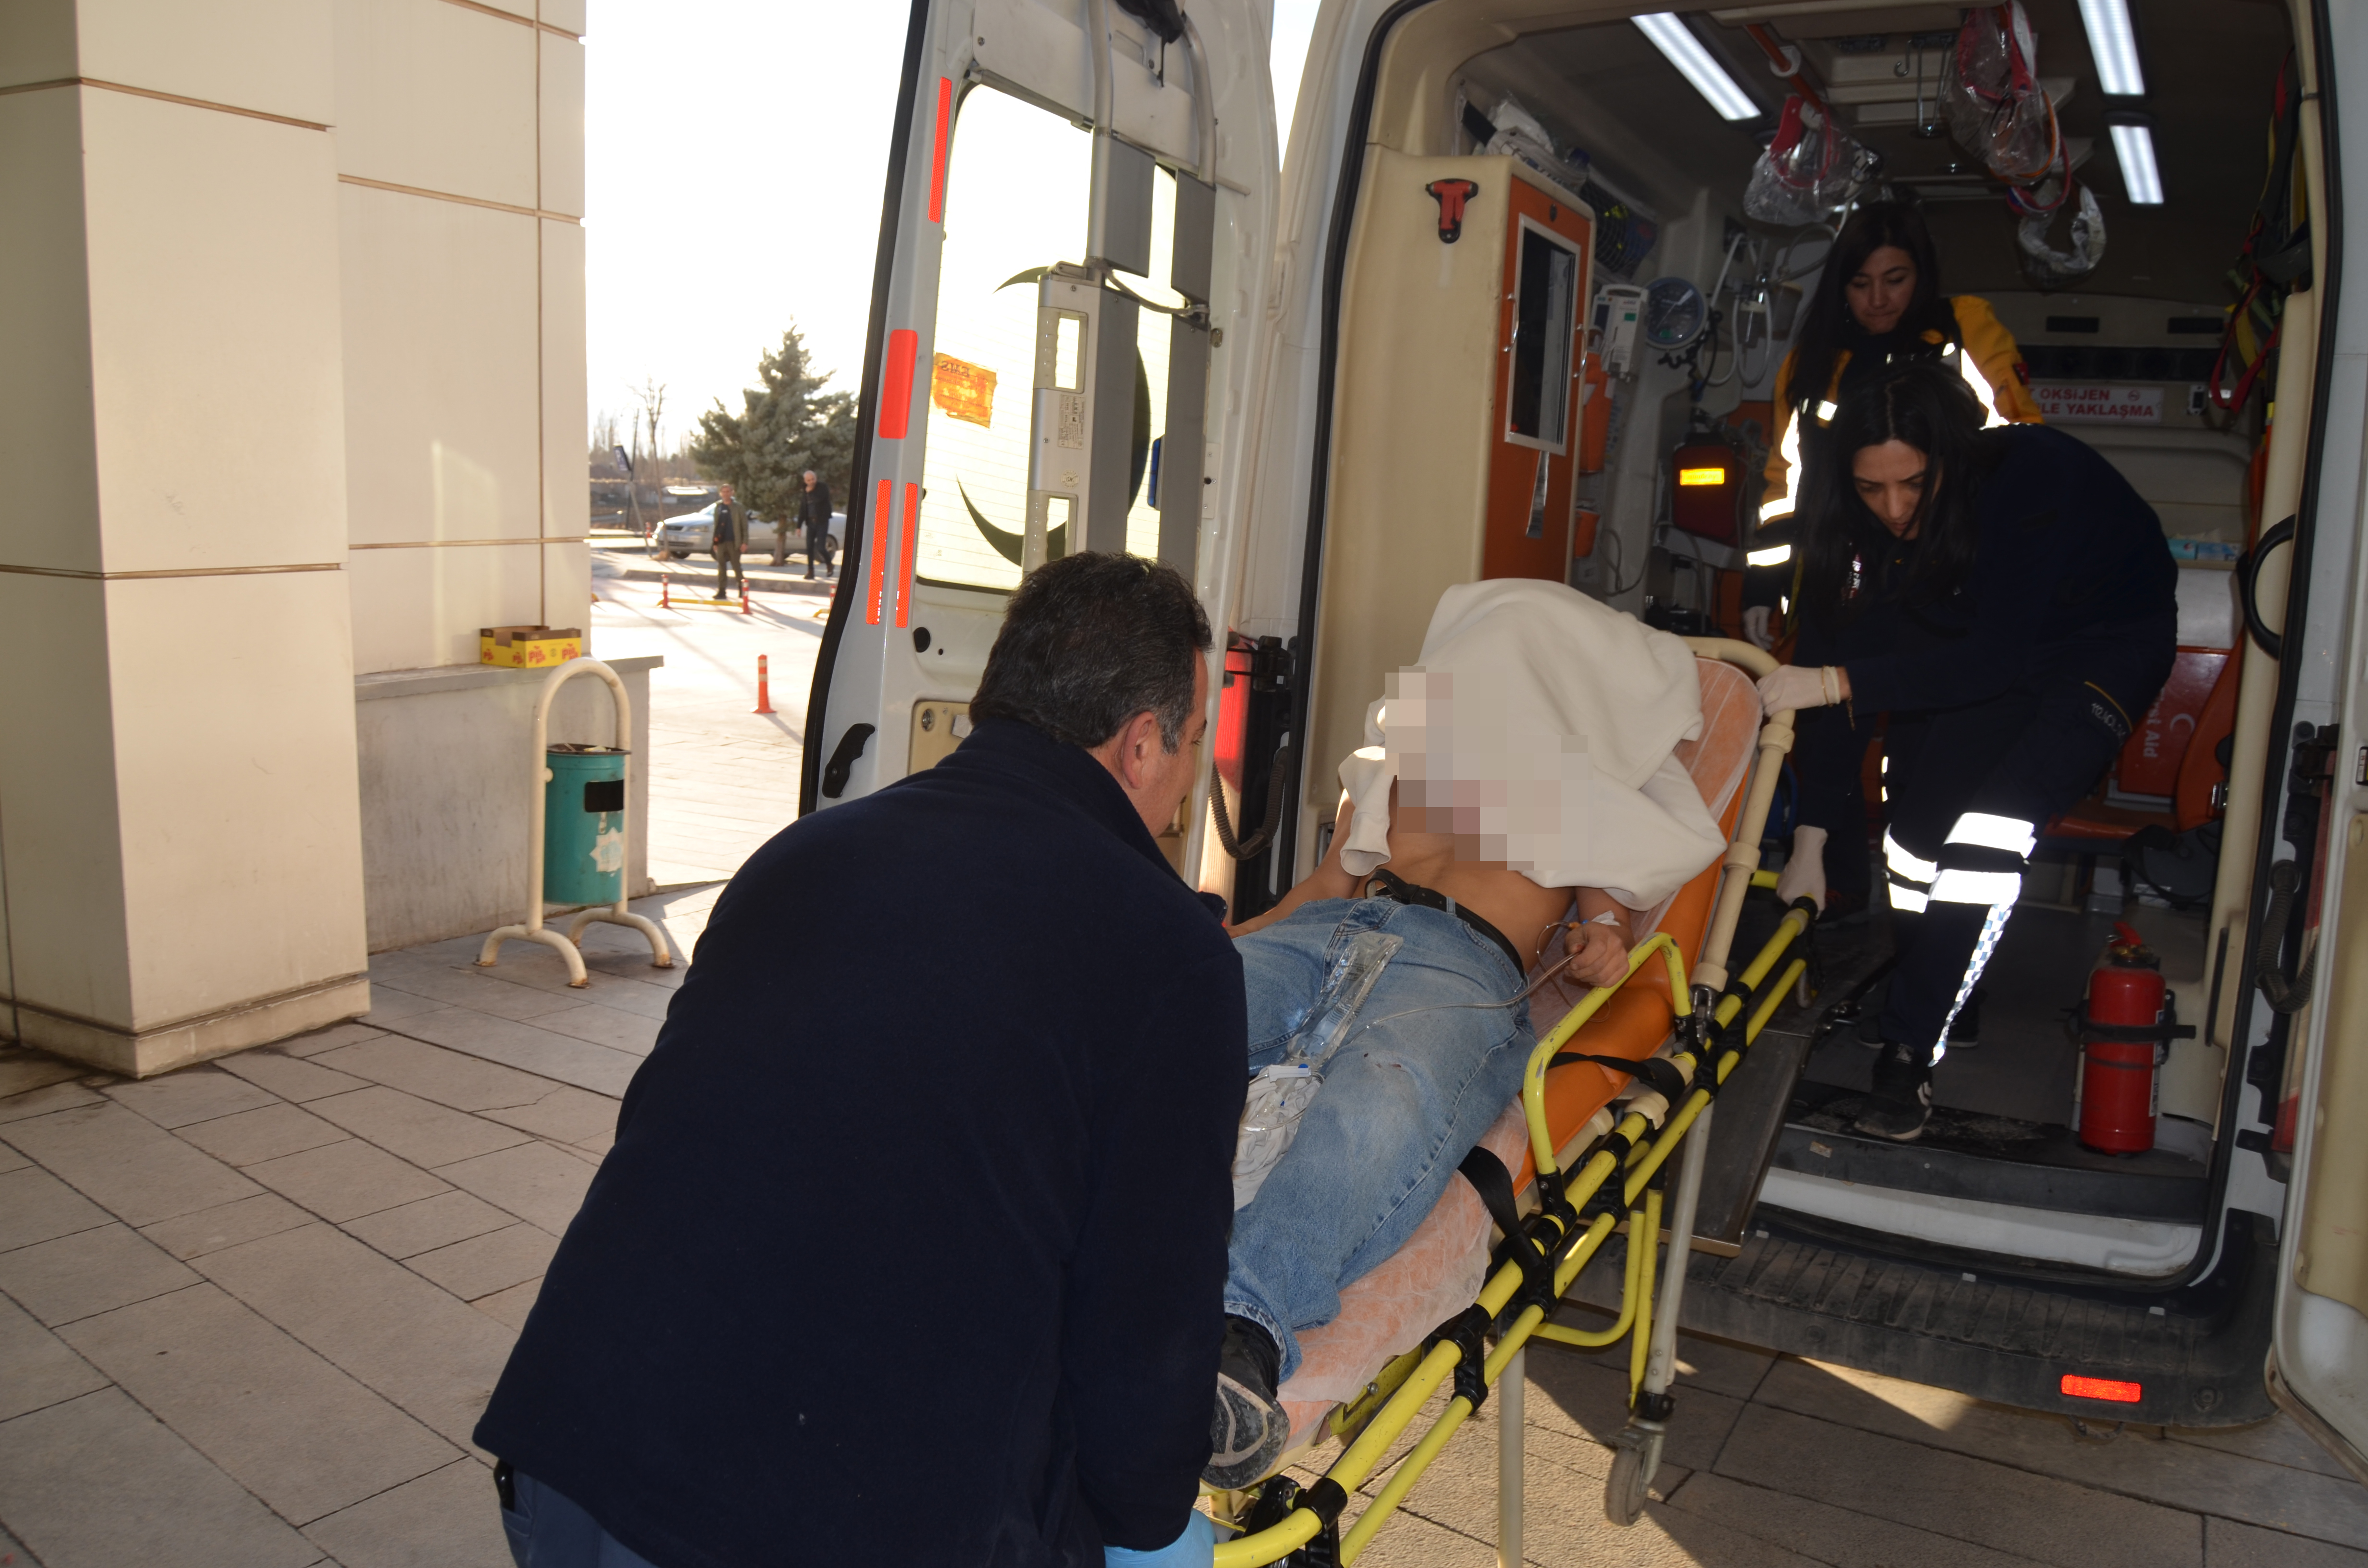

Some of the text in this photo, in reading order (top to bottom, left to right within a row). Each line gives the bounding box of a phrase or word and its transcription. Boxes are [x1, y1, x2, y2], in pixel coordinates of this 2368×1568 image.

[2040, 388, 2110, 401] OKSİJEN
[2067, 404, 2154, 418] YAKLAŞMA
[2143, 687, 2165, 758] rst Aid
